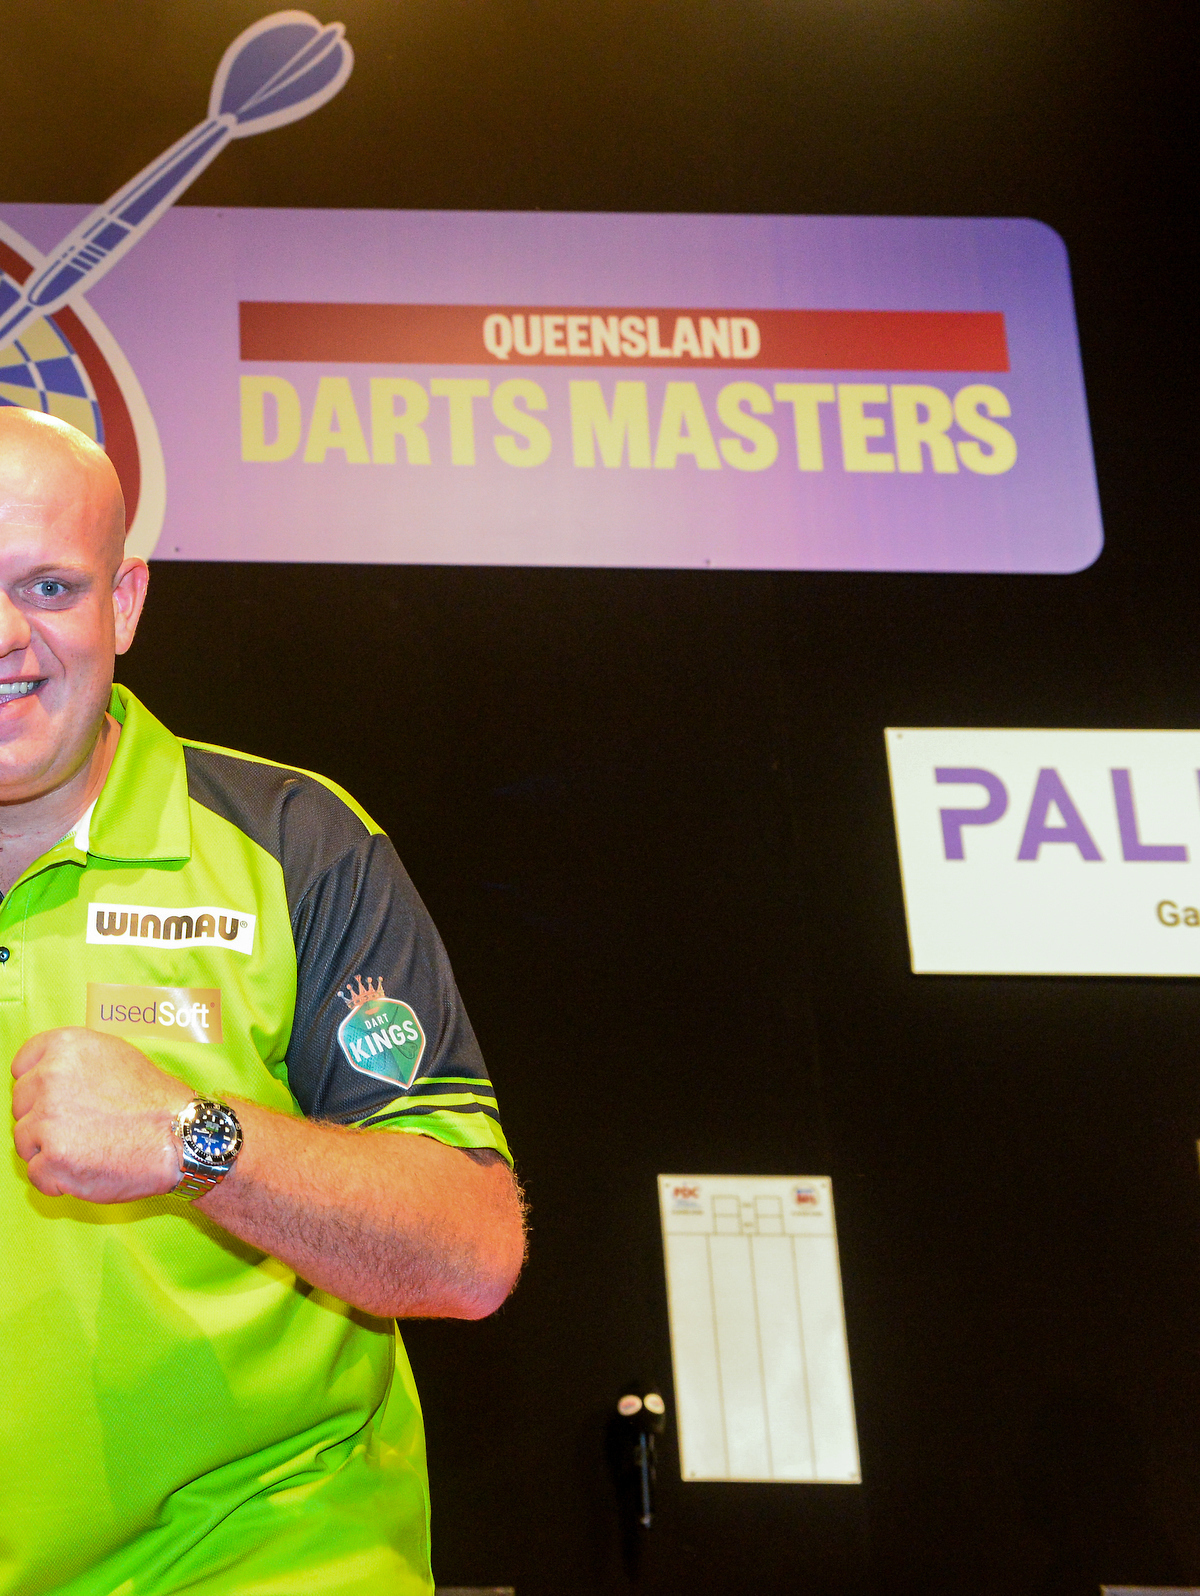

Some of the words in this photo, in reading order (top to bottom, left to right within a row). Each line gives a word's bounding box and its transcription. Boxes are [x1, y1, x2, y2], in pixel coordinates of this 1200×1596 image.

[483, 313, 761, 361] QUEENSLAND
[239, 375, 552, 468] DARTS
[568, 379, 1019, 475] MASTERS
[933, 766, 1200, 863] PAL
[349, 1020, 419, 1063] KINGS
[364, 1012, 390, 1030] DART
